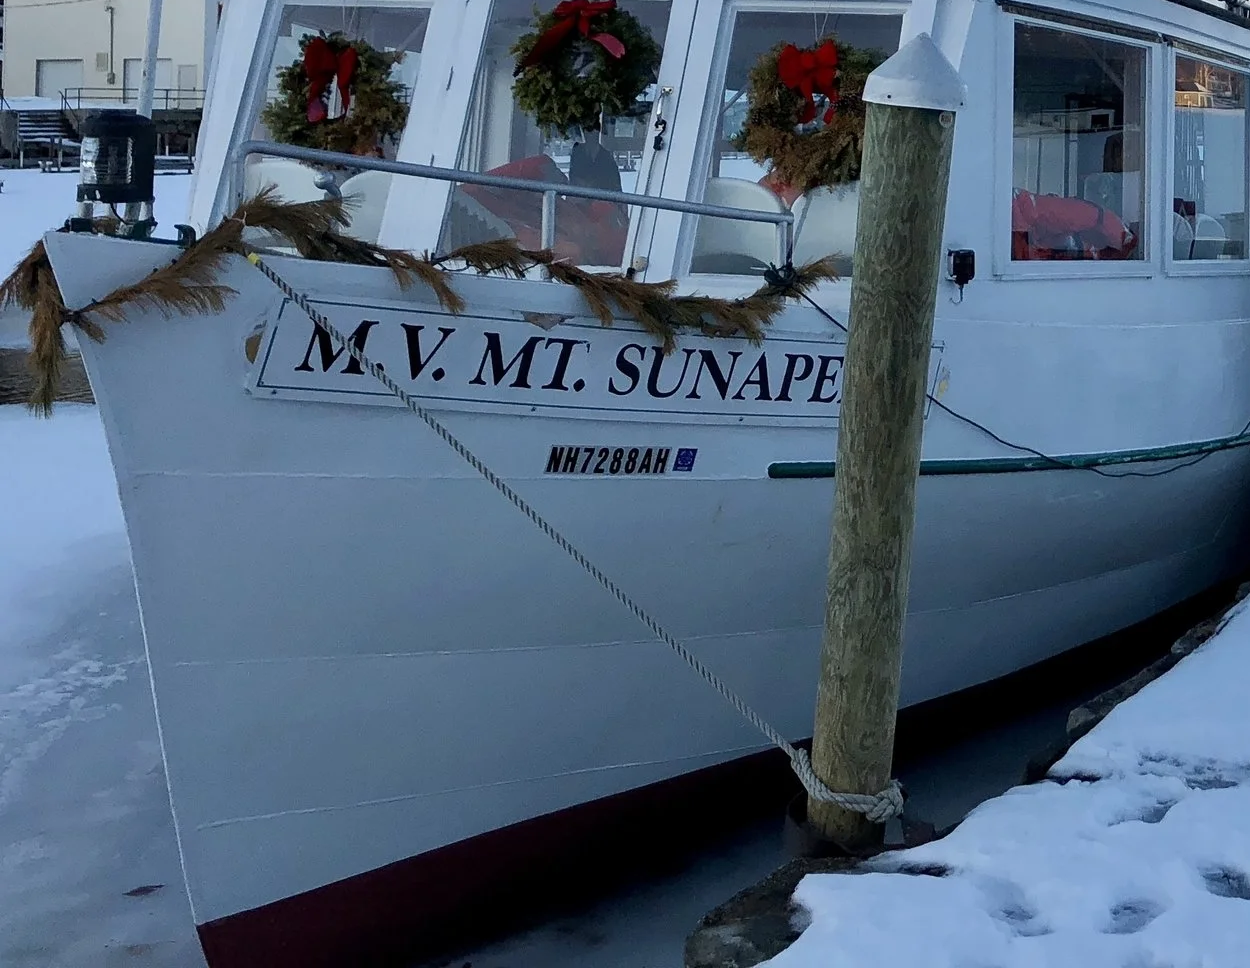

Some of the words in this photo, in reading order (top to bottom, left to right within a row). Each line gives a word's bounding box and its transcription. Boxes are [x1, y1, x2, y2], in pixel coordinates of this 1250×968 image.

[469, 332, 590, 392] MT.
[608, 343, 845, 404] SUNAPE
[546, 447, 671, 474] NH7288AH
